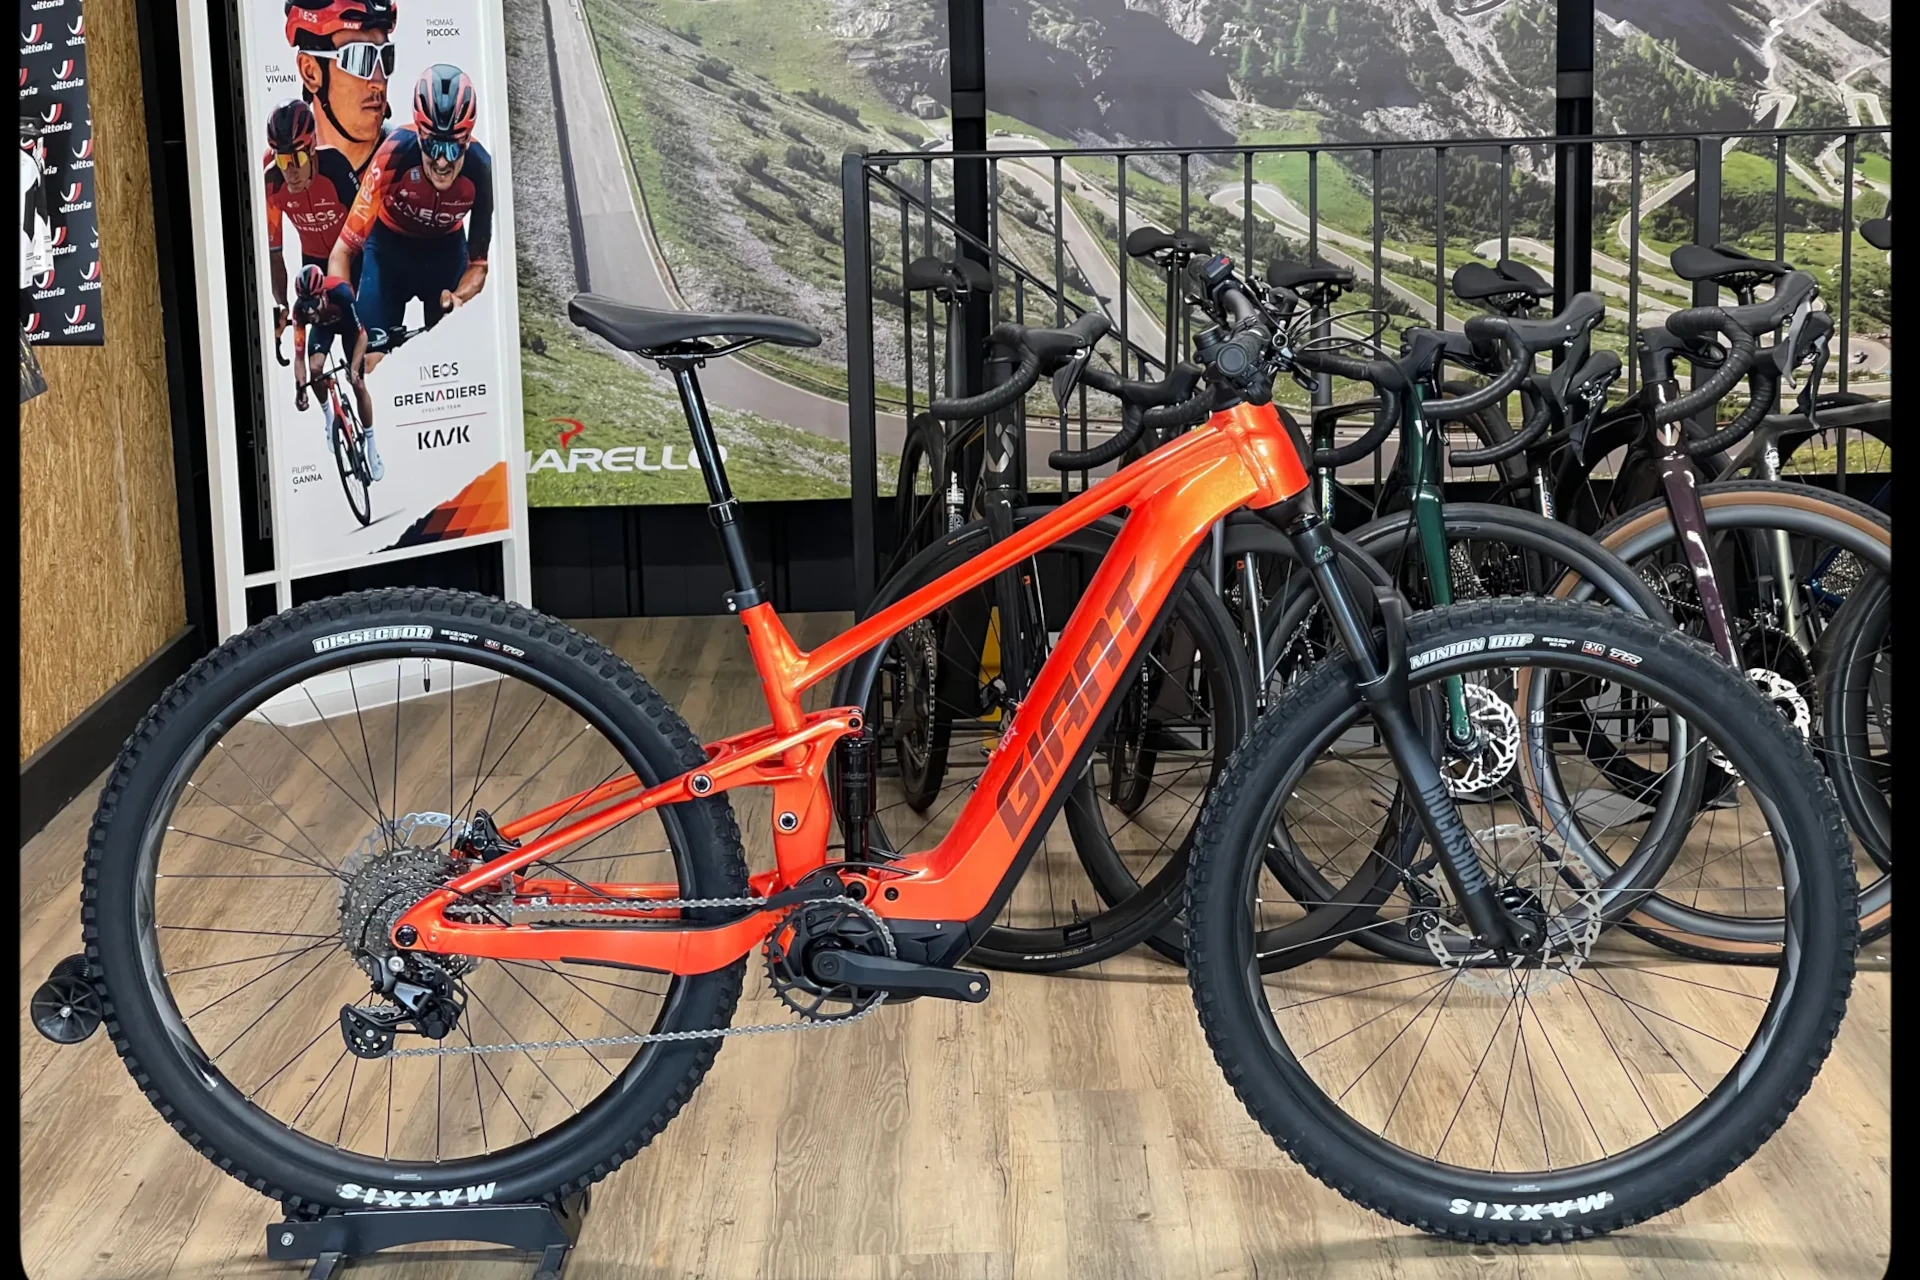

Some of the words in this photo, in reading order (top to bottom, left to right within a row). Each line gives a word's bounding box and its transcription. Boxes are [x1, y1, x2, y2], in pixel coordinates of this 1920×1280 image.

[426, 18, 454, 26] THOMAS
[426, 28, 460, 37] PIDCOCK
[20, 42, 53, 55] vittoria
[265, 64, 280, 73] ELIA
[51, 77, 84, 91] vittoria
[265, 74, 297, 83] VIVIANI
[40, 121, 73, 135] vittoria
[59, 200, 92, 213] vittoria
[292, 209, 336, 224] INEOS
[32, 286, 66, 300] vittoria
[63, 322, 96, 335] vittoria
[419, 361, 459, 381] INEOS
[394, 384, 487, 407] GRENADIERS
[421, 406, 445, 414] CYCLING
[417, 424, 471, 450] KASK
[524, 444, 728, 474] ARELLO
[291, 463, 316, 474] FILIPPO
[292, 473, 323, 485] GANNA
[312, 625, 434, 654] DISSECTOR
[1410, 637, 1486, 670] MINION
[1488, 633, 1535, 650] DHF
[1581, 640, 1606, 657] EXO
[996, 556, 1142, 842] GIANT
[1422, 783, 1489, 896] ROCKSHOX
[337, 1182, 496, 1208] MAXXIS
[1448, 1191, 1613, 1222] MAXXIS
